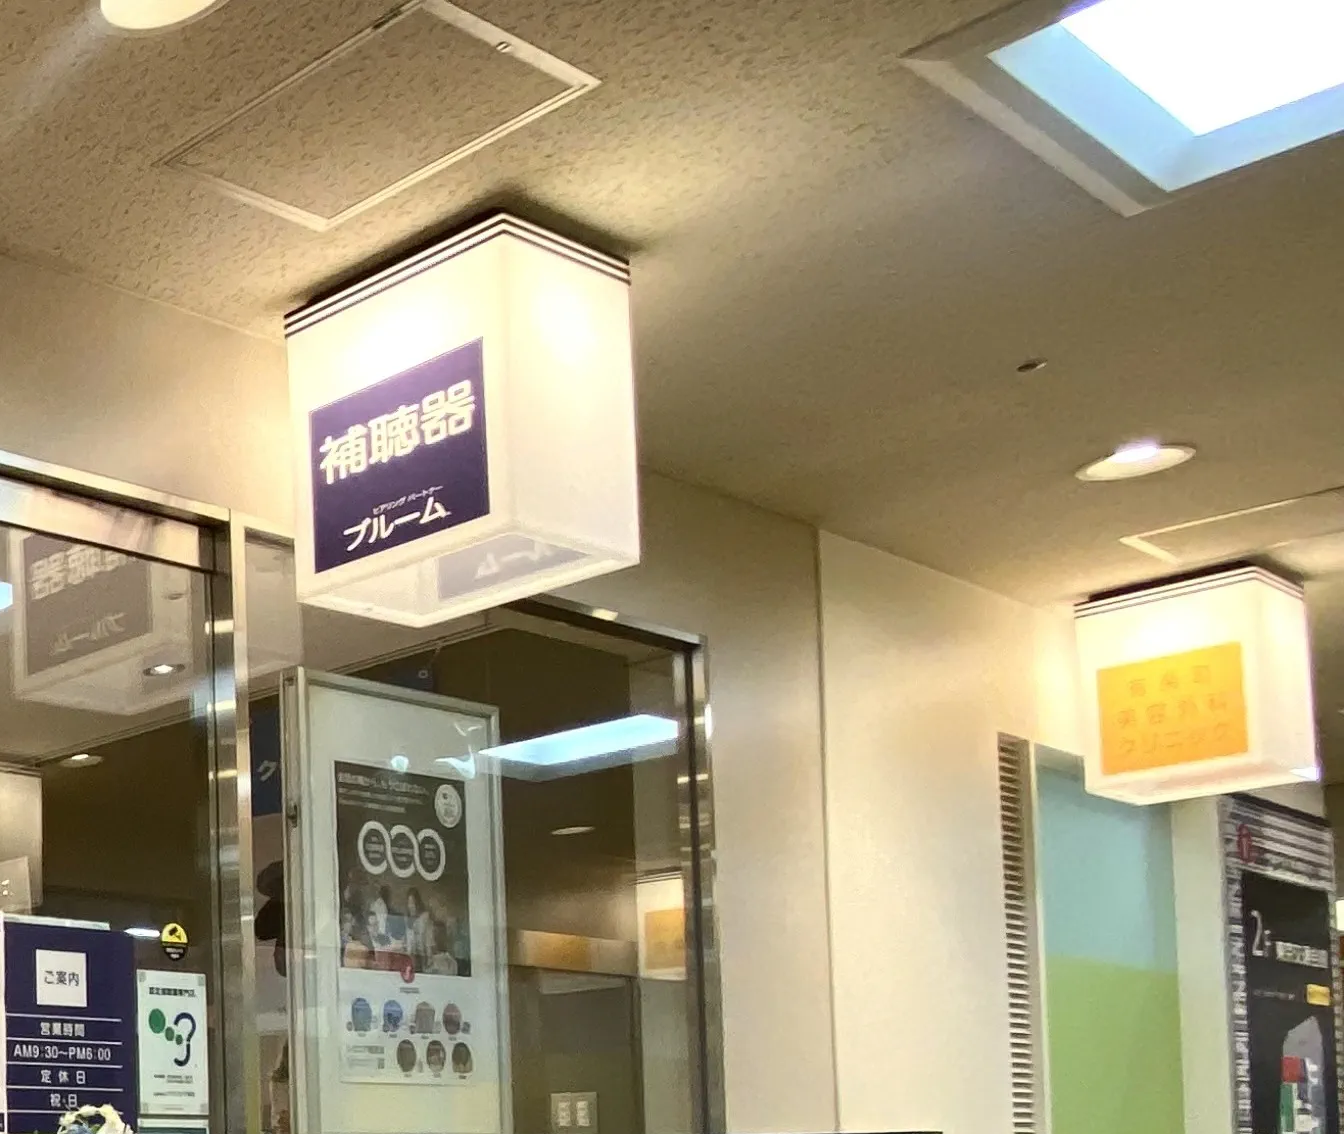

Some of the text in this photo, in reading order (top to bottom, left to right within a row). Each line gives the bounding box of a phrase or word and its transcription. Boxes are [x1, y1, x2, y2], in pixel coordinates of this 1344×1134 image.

[318, 378, 476, 486] 補聴器
[342, 496, 448, 552] ブルーム
[43, 970, 80, 987] ご案内
[40, 1021, 86, 1038] 営業時間
